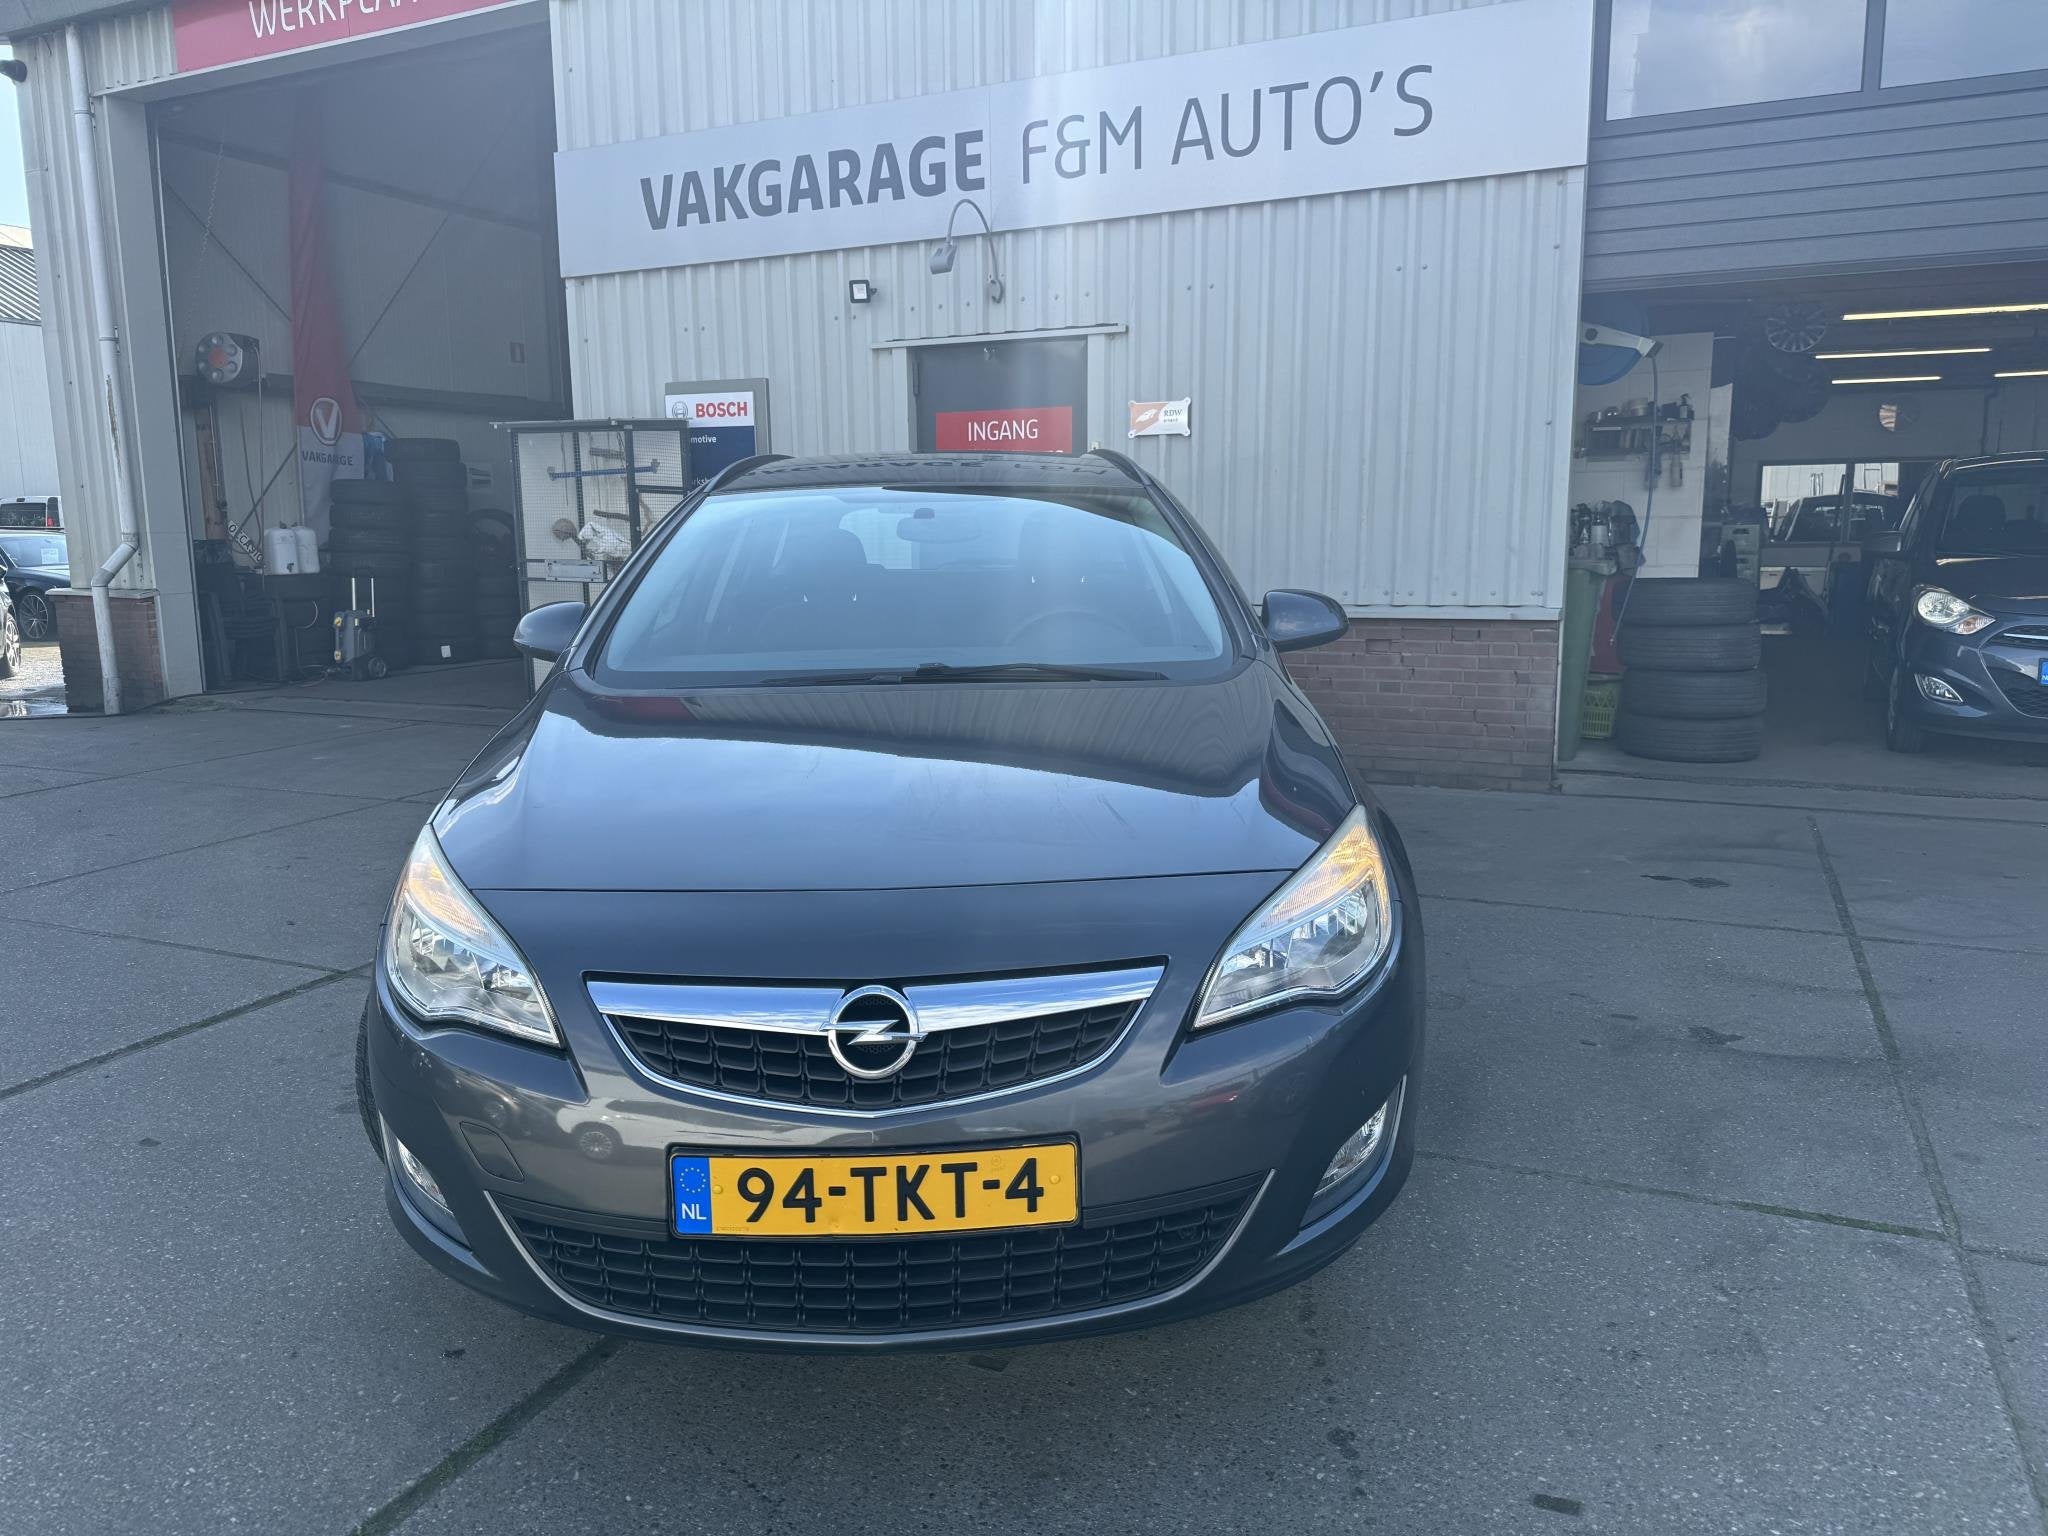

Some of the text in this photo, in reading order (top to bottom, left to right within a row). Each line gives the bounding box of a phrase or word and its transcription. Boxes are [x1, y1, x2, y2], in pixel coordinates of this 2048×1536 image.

[249, 0, 418, 39] WERKP
[640, 64, 1434, 232] VAKGARAGE F&M AUTO'S
[695, 401, 748, 418] BOSCH
[968, 419, 1038, 442] INGANG
[681, 1157, 1045, 1223] NL 94-TKT-4
